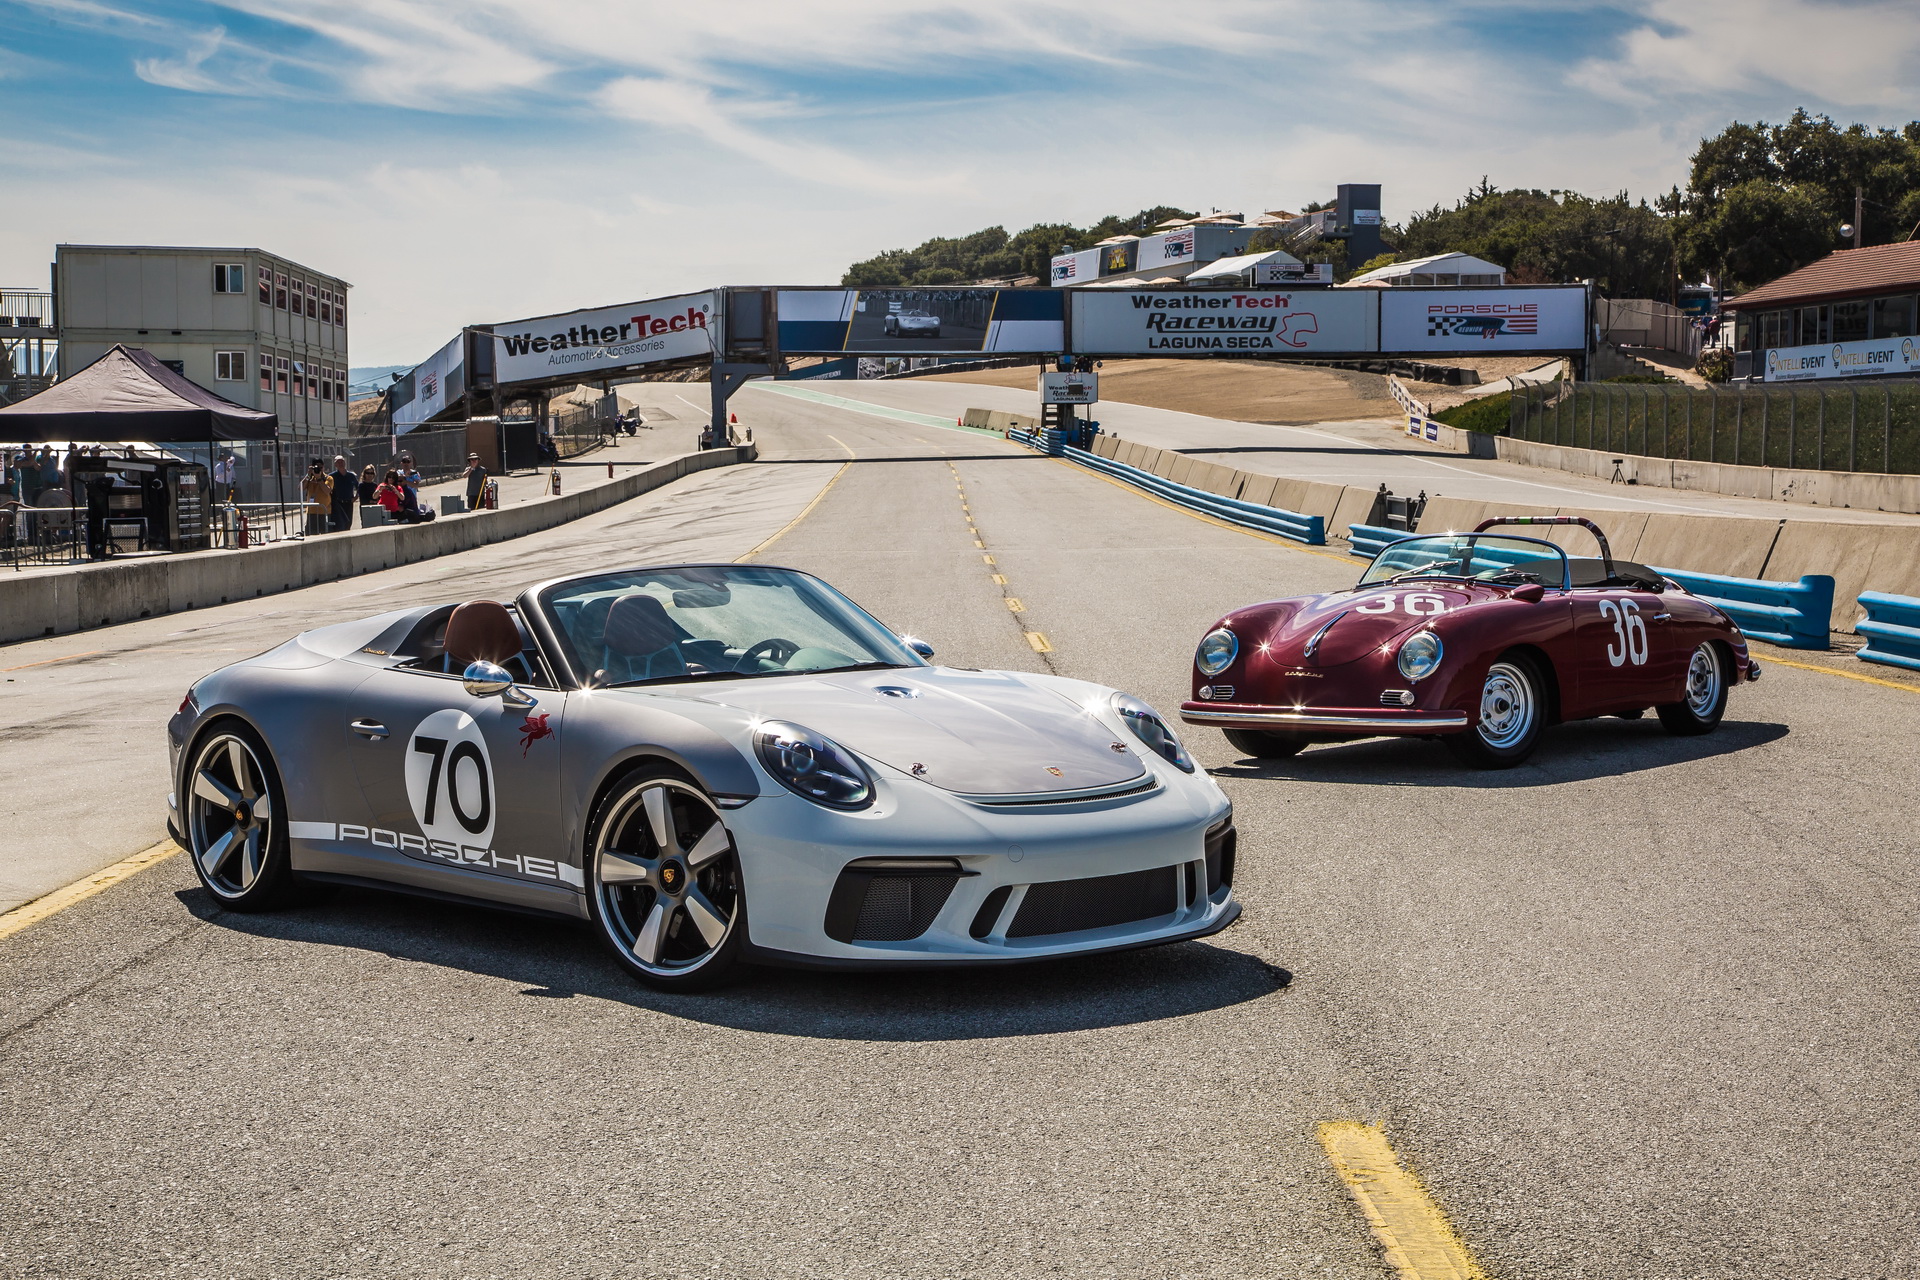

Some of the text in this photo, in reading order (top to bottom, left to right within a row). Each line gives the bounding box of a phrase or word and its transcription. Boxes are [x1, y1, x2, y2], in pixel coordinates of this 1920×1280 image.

[1165, 232, 1193, 243] PORSCHE
[1428, 304, 1538, 314] PORSCHE
[1146, 312, 1278, 334] Raceway
[548, 339, 665, 366] Automotive Accessories
[1149, 337, 1273, 349] LAGUNA SECA
[1776, 356, 1826, 371] INTELLIEVENT
[1840, 350, 1895, 365] INTELLIEVENT
[1355, 593, 1445, 616] 36
[1599, 598, 1648, 667] 36
[414, 735, 491, 835] 70
[339, 823, 557, 879] PORSCHE
